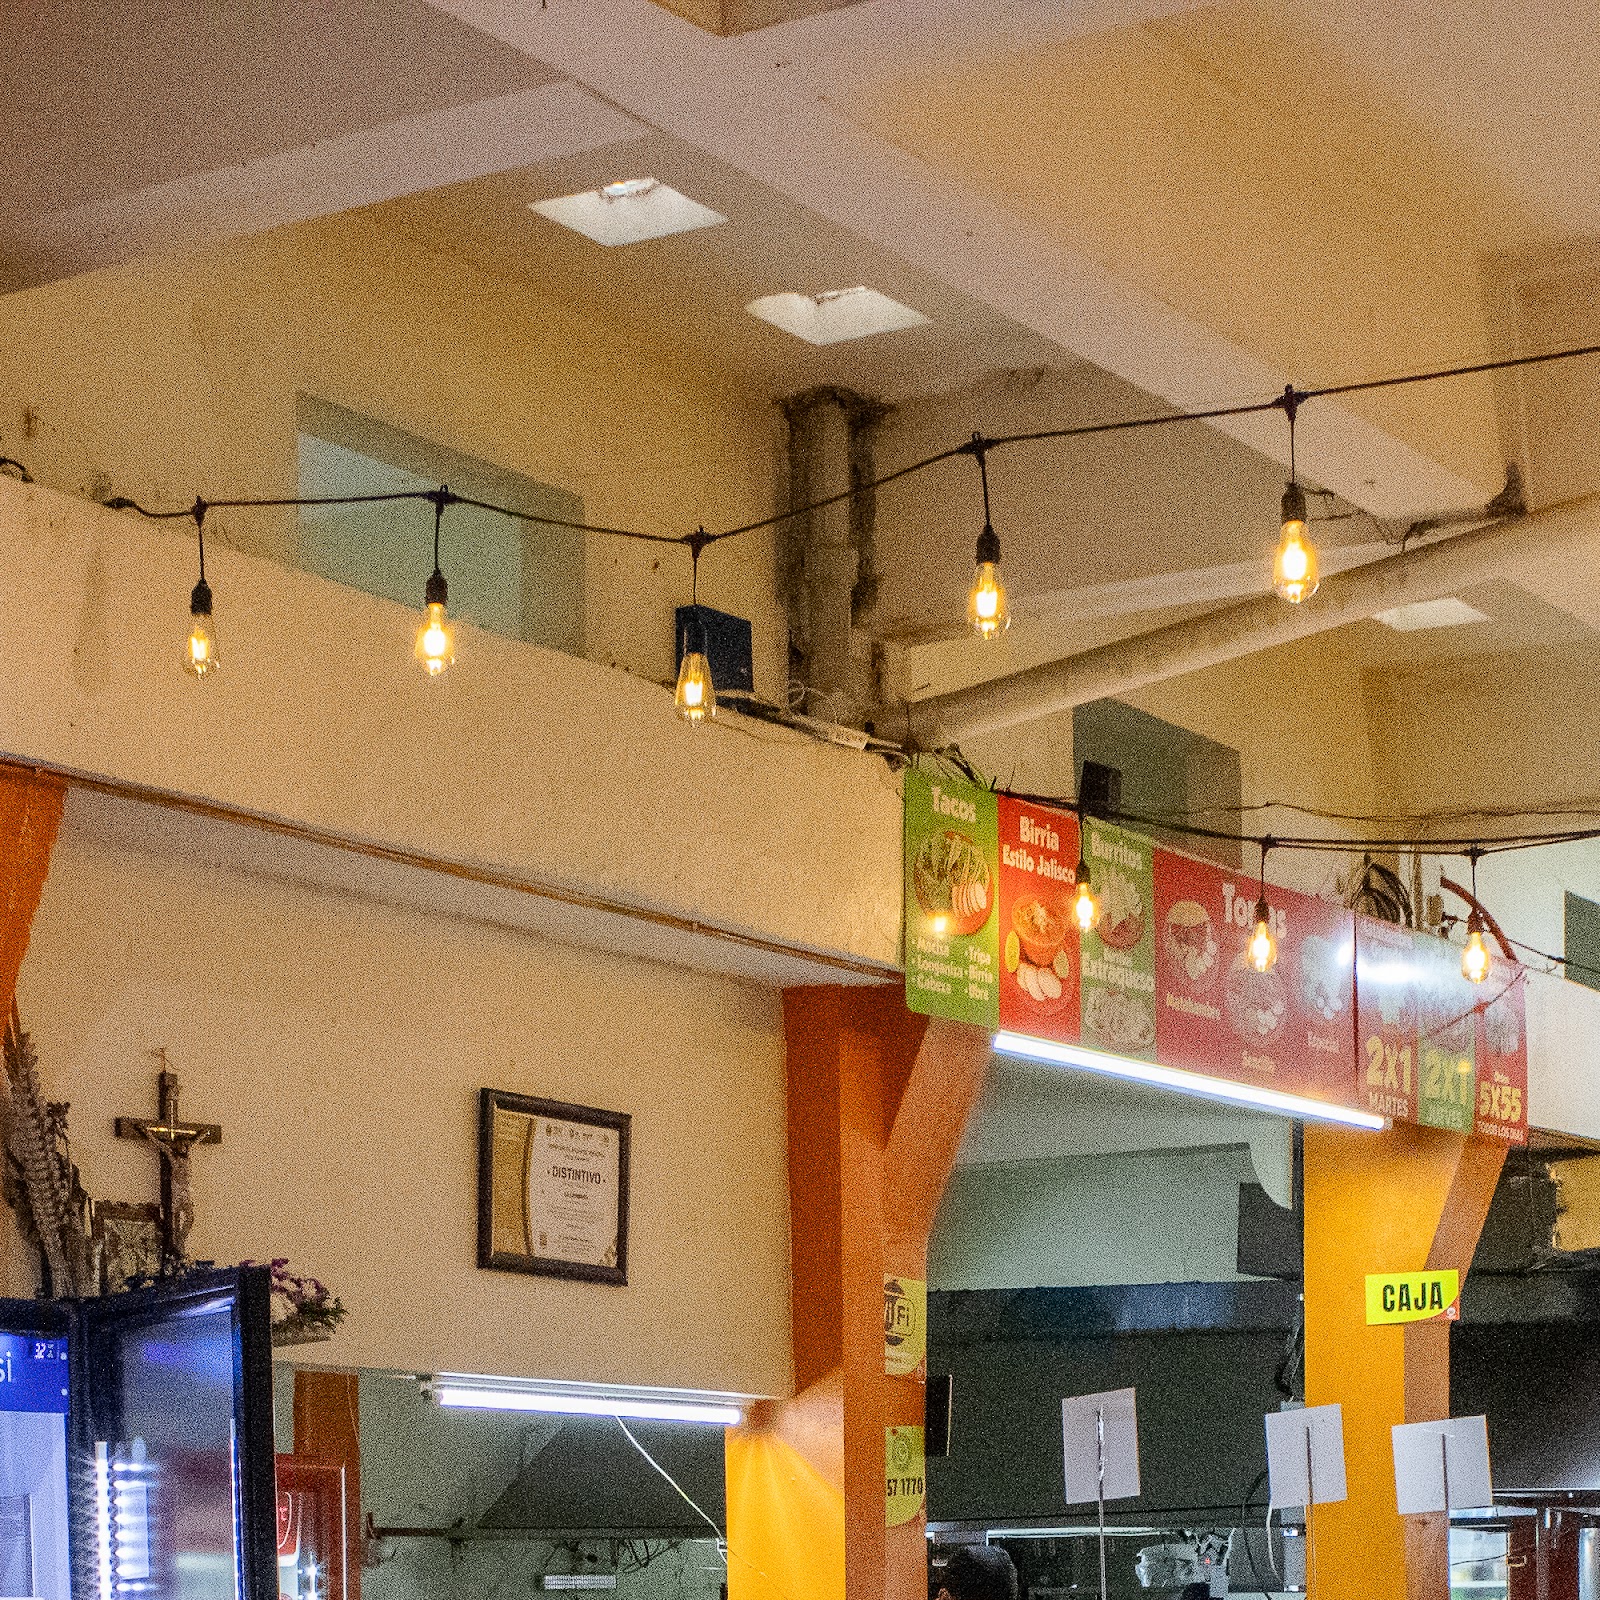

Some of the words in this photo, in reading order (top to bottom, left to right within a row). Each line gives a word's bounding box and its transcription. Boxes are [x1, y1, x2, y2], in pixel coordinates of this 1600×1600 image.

[931, 786, 977, 823] Tacos
[1019, 816, 1060, 851] Birria
[1002, 845, 1035, 872] Estilo
[1036, 852, 1077, 885] Jalisco
[551, 1166, 602, 1185] DISTINTIVO
[1381, 1282, 1444, 1313] CAJA
